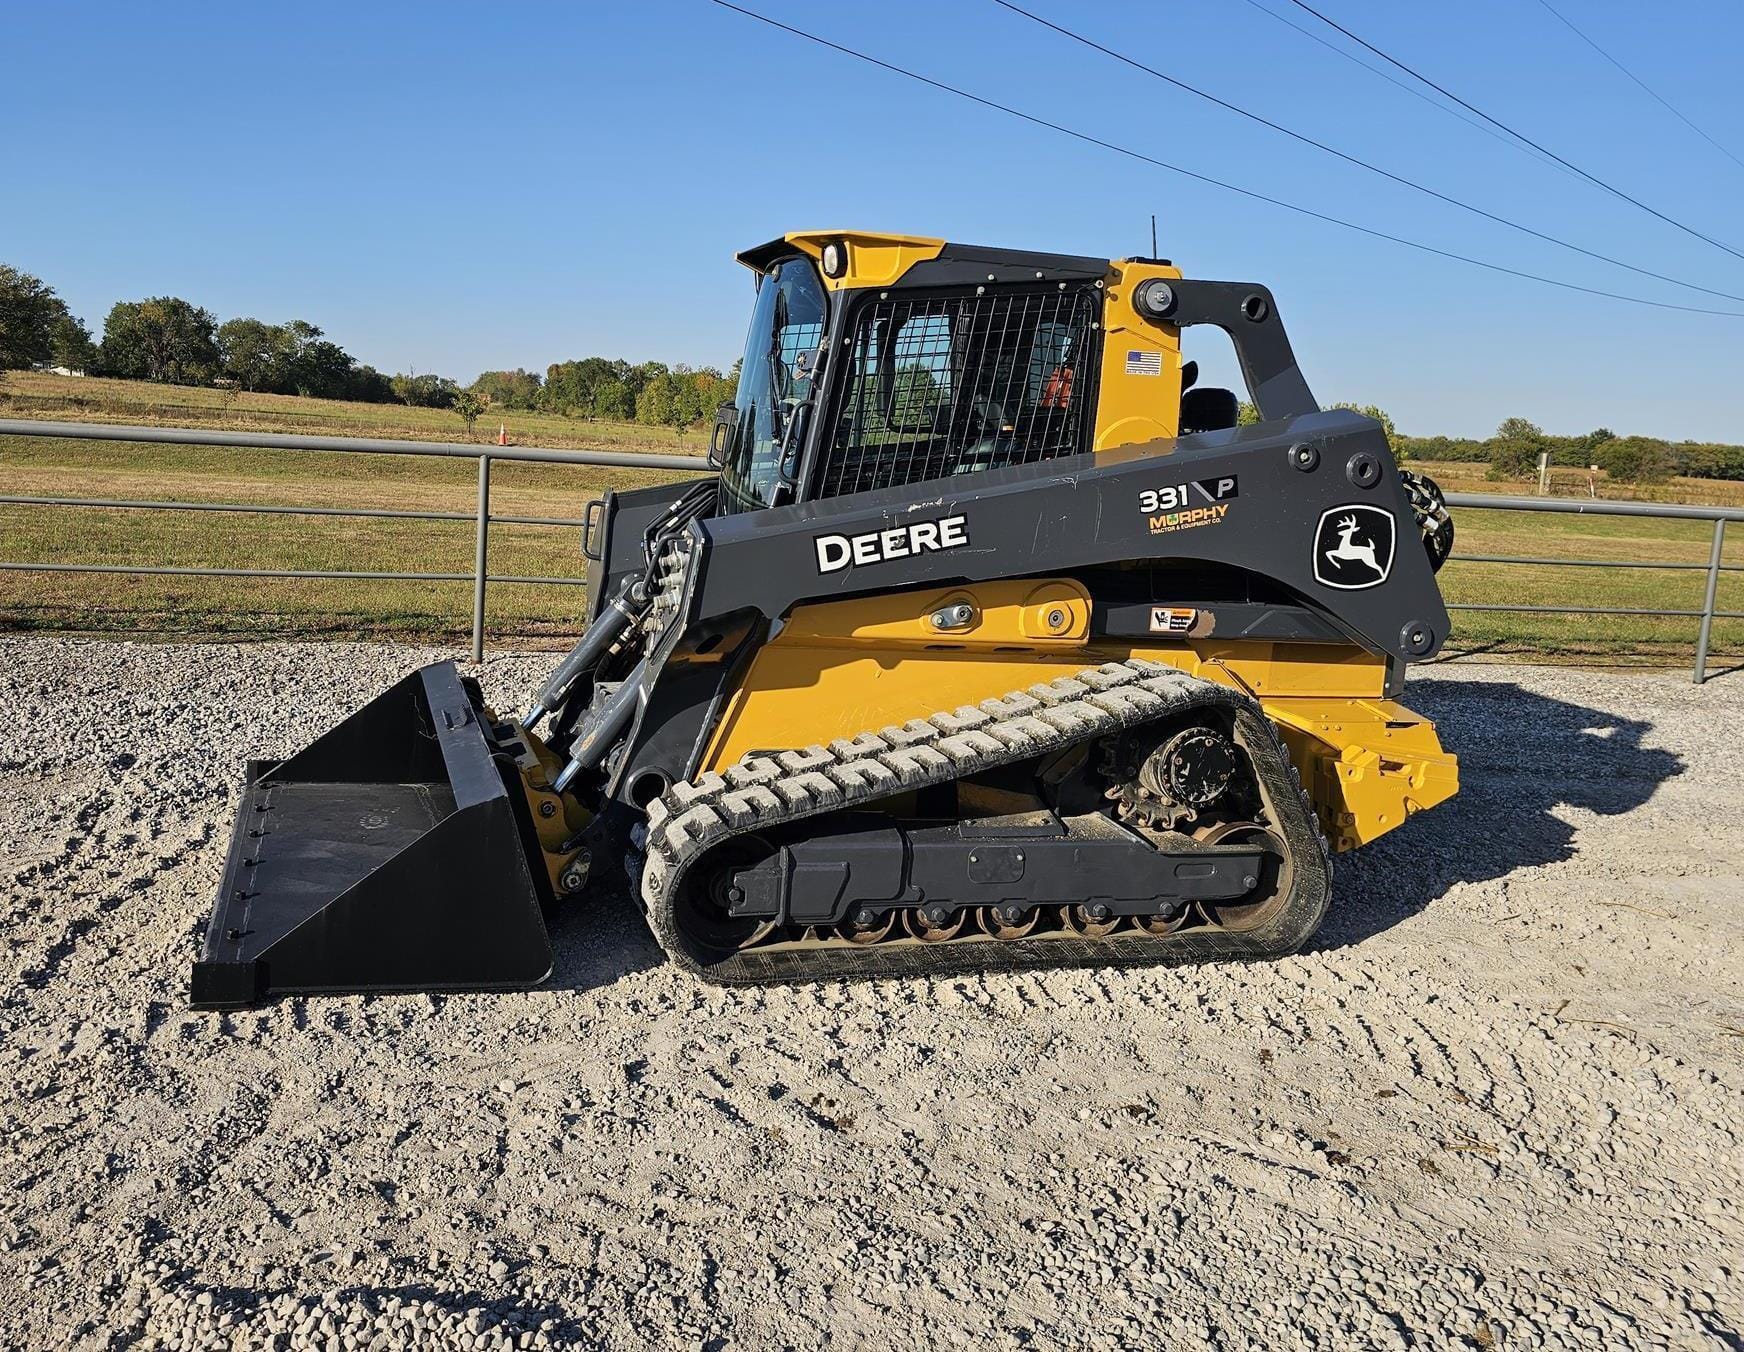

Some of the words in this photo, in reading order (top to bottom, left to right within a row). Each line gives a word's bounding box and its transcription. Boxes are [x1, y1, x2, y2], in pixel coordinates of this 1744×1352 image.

[1139, 484, 1188, 513] 331
[1217, 478, 1235, 498] P
[1149, 503, 1229, 530] MURPHY
[1150, 525, 1176, 535] TRACTOR
[1181, 519, 1211, 530] EQUIPMENT
[816, 516, 968, 573] DEERE
